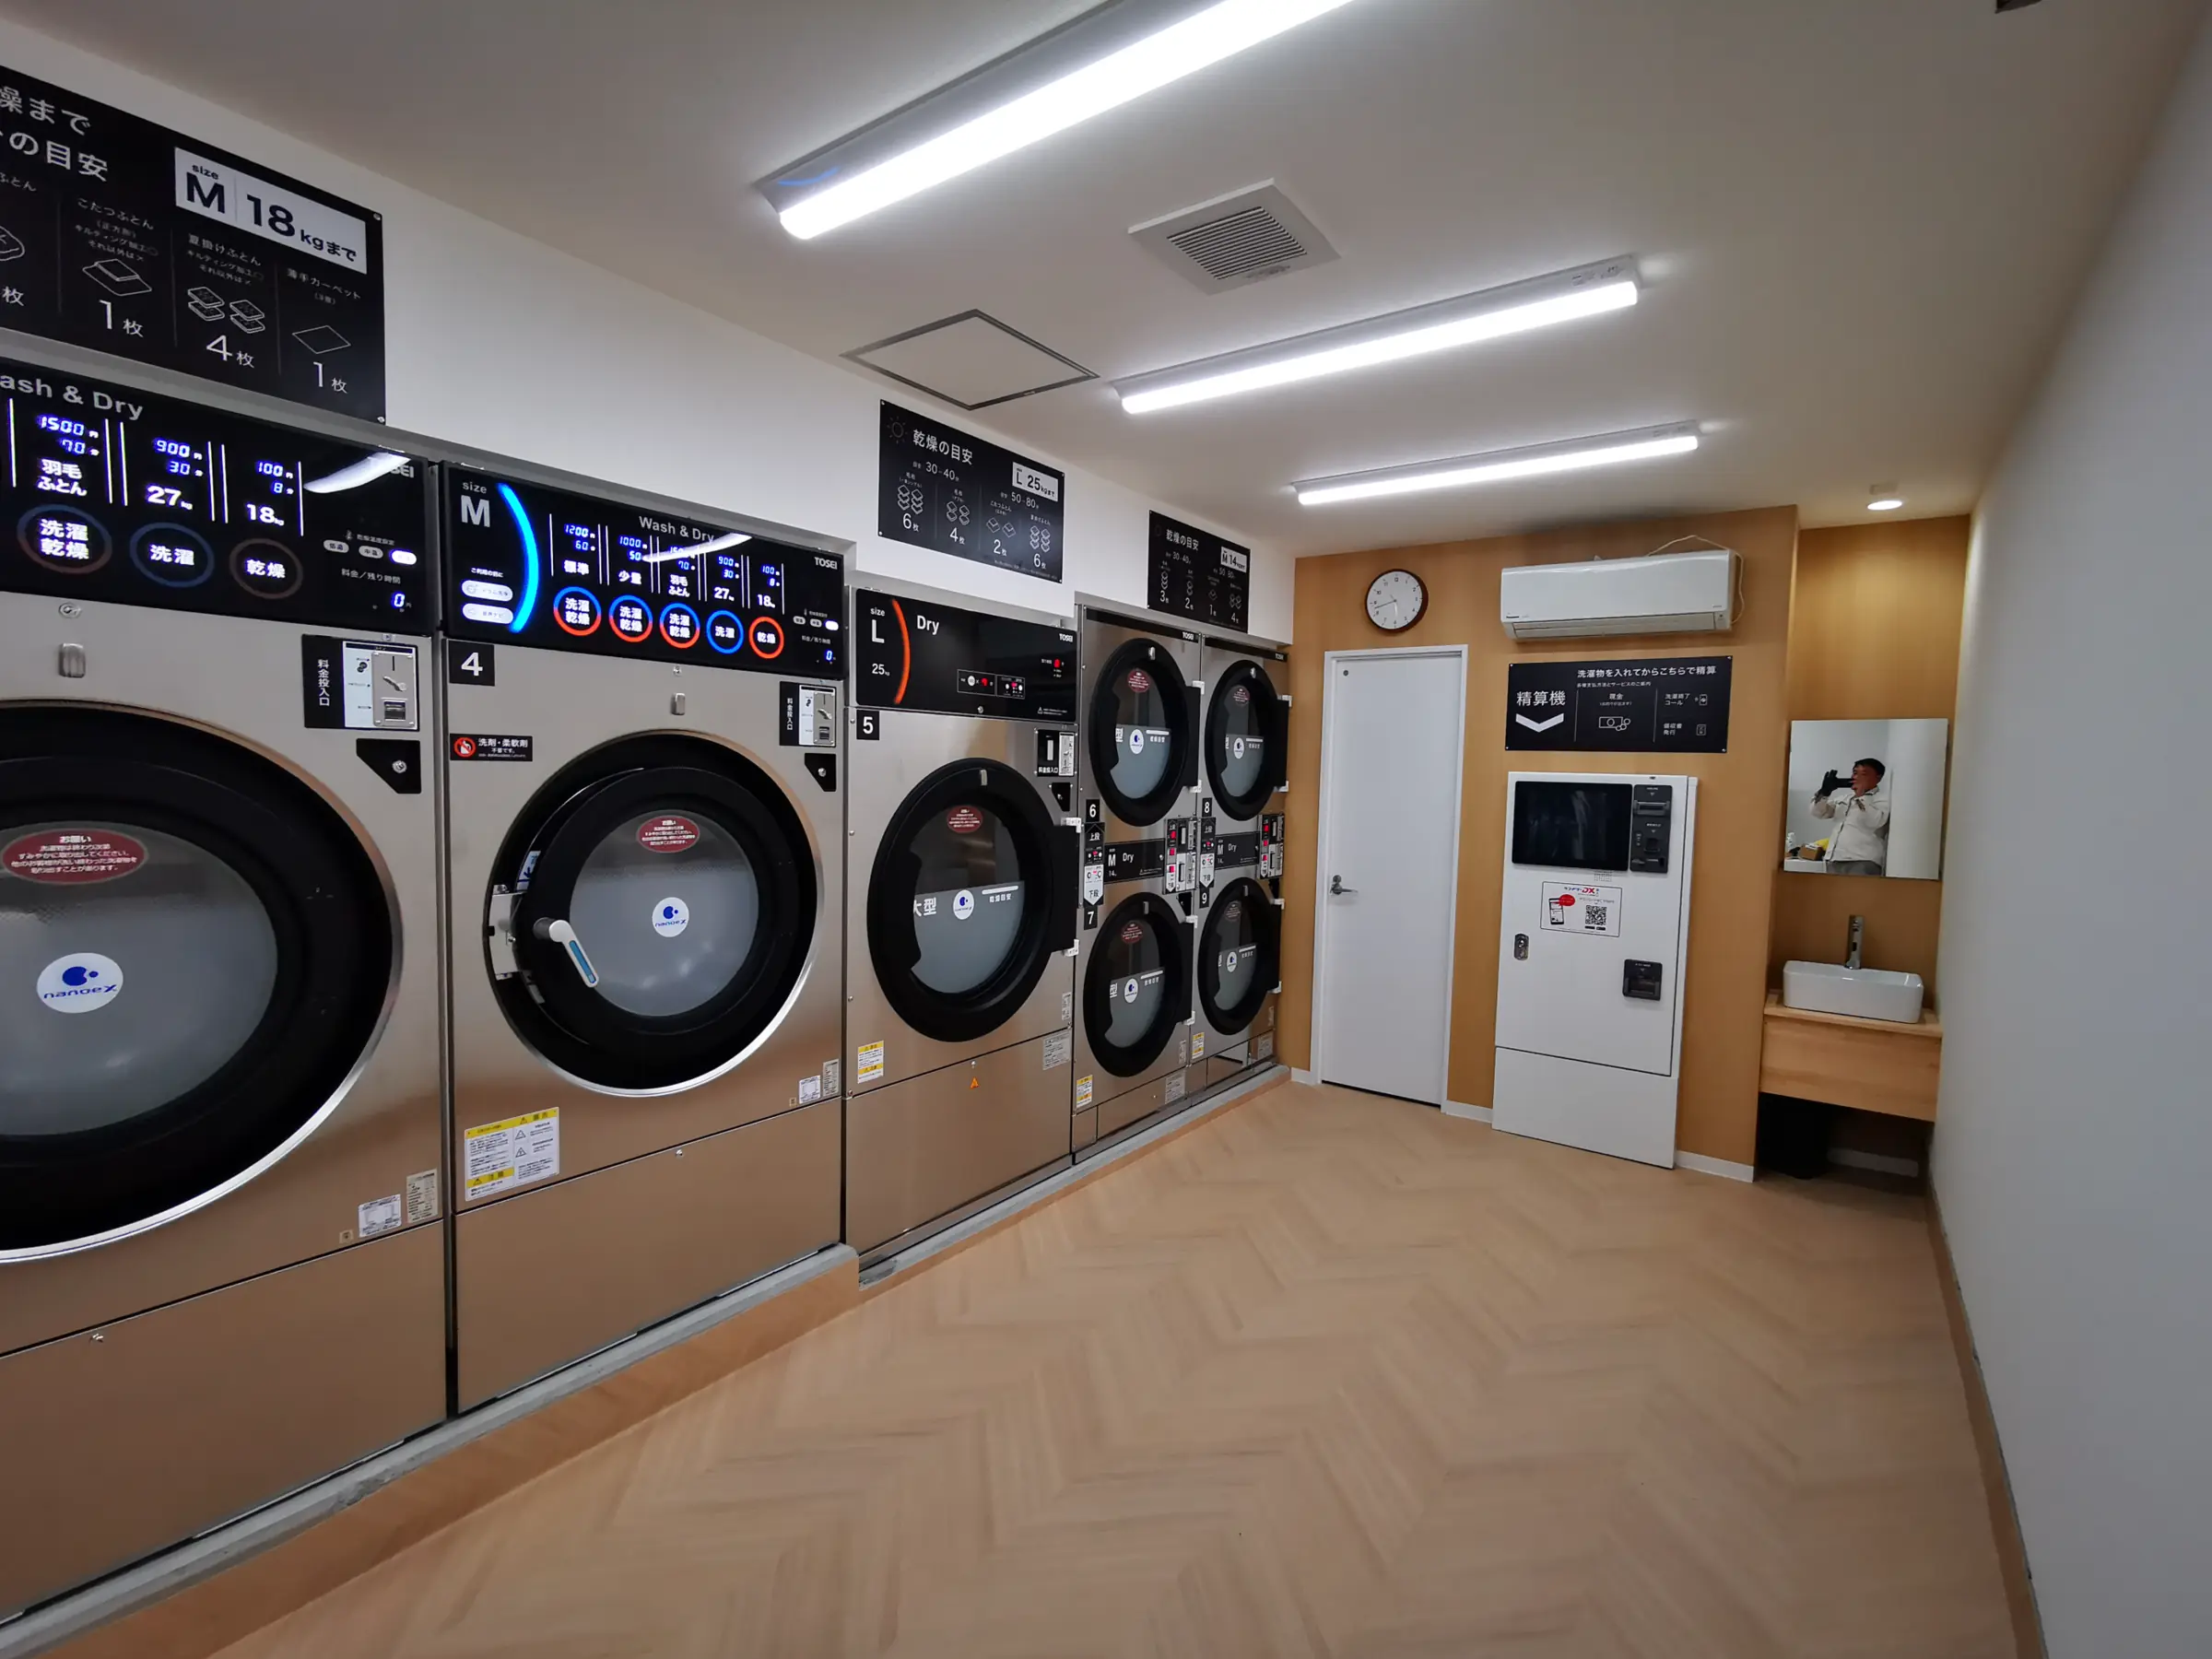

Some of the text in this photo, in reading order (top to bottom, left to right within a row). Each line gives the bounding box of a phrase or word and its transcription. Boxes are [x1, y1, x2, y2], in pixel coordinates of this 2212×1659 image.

[0, 131, 108, 182] の目安
[192, 163, 219, 180] size
[186, 172, 225, 213] M
[77, 197, 153, 229] こたつふとん
[63, 385, 84, 405] &
[93, 392, 144, 420] Dry
[912, 429, 973, 465] 乾燥の目安
[463, 481, 487, 494] size
[461, 495, 490, 527] M
[41, 518, 88, 541] 洗濯
[639, 516, 676, 535] Wash
[679, 525, 689, 537] &
[1166, 529, 1199, 550] 乾燥の目安
[150, 544, 194, 566] 洗濯
[814, 557, 838, 570] TOSEI
[394, 593, 405, 607] 0
[870, 607, 885, 617] size
[871, 619, 885, 643] L
[917, 615, 939, 635] Dry
[461, 652, 483, 677] 4
[1577, 665, 1716, 678] 洗濯物を入れてからこちらで精算
[318, 659, 330, 706] 料金投入口
[1516, 690, 1566, 706] 精算機
[863, 716, 874, 734] 5
[1089, 804, 1097, 818] 6
[1204, 802, 1209, 813] 8
[1108, 853, 1116, 866] M
[1123, 853, 1135, 864] Dry
[1202, 893, 1207, 904] 9
[1088, 912, 1095, 924] 7
